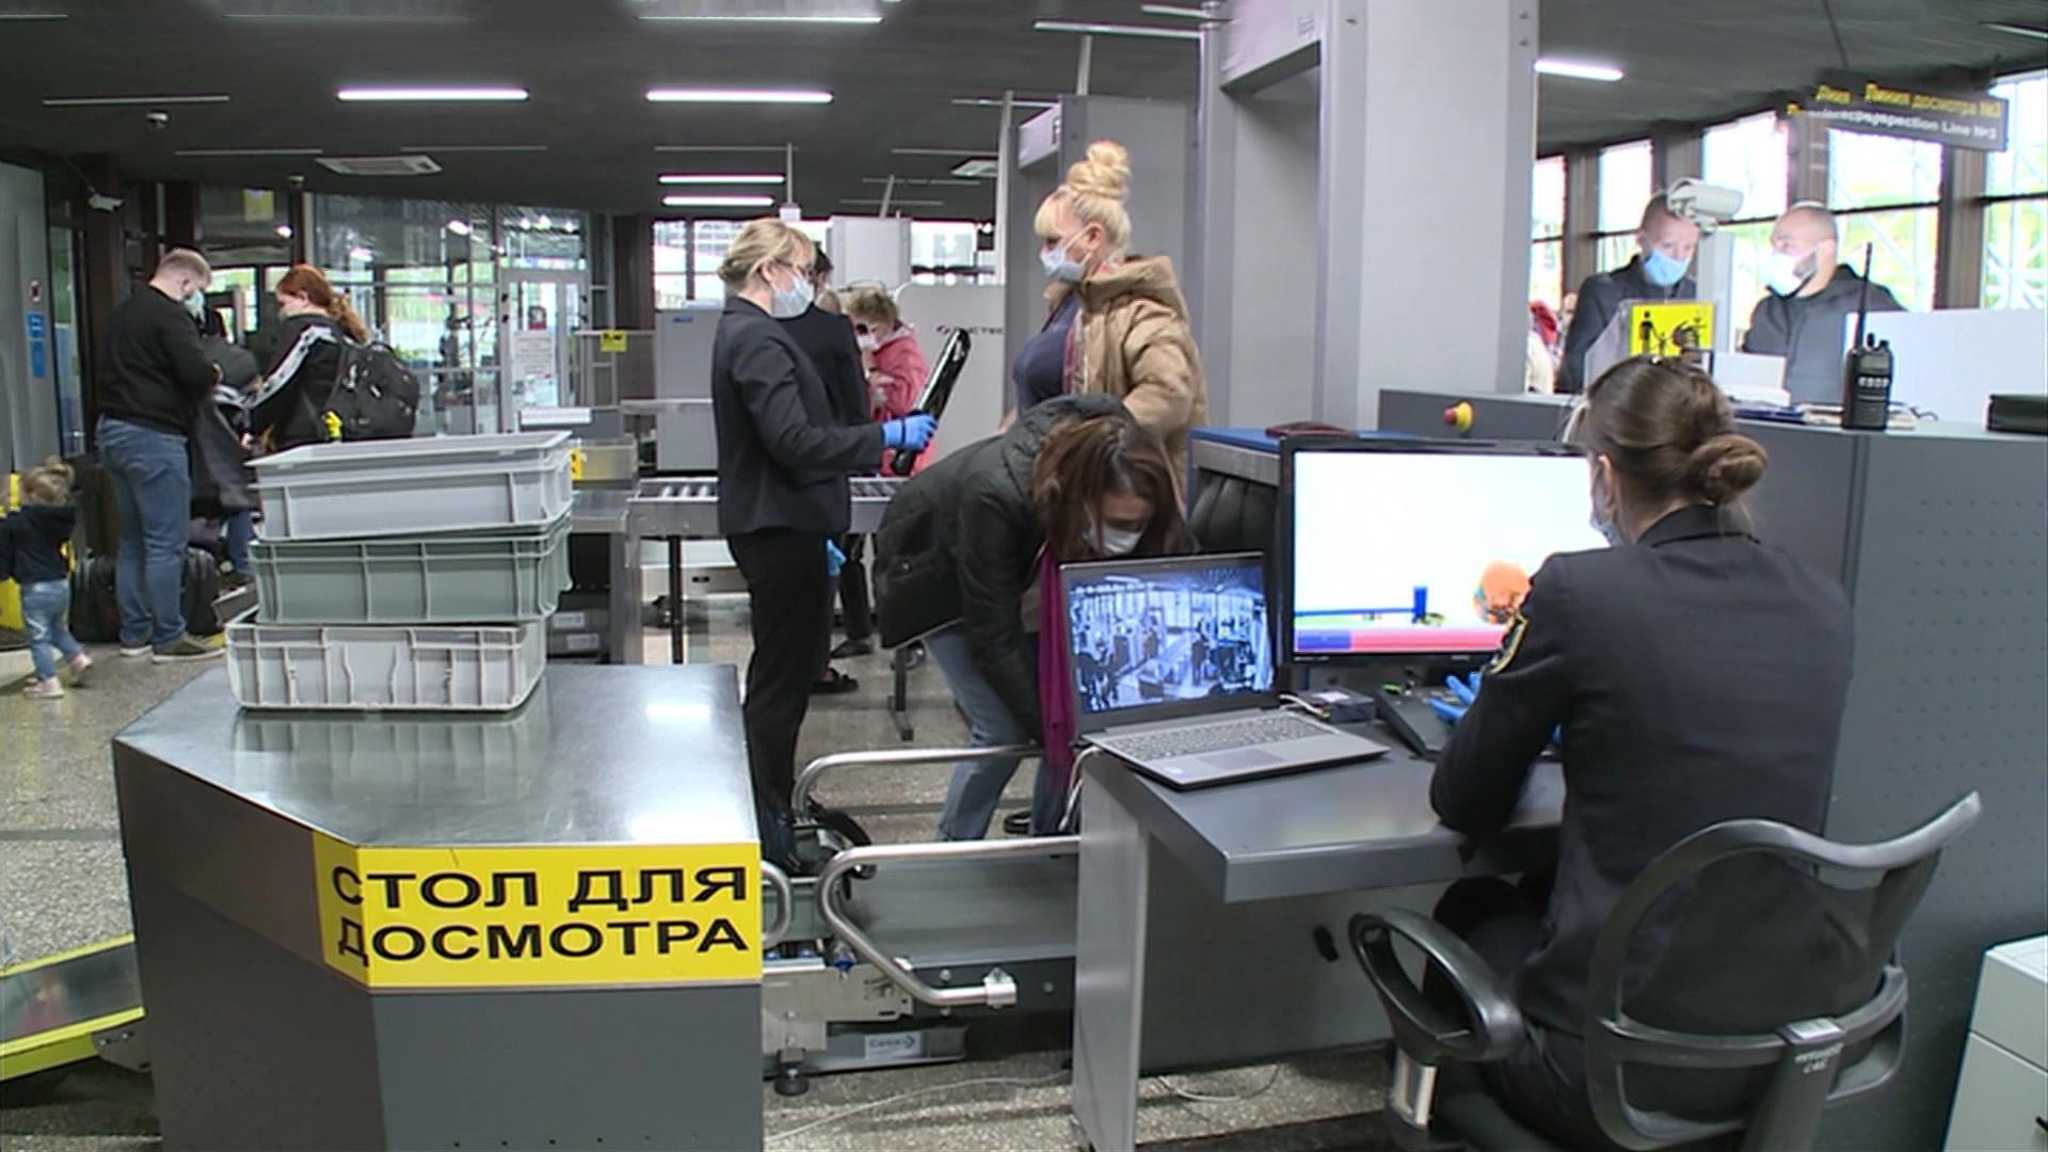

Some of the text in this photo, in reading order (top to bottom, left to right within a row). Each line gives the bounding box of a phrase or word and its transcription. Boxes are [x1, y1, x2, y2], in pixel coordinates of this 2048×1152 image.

[1941, 121, 1971, 136] Line
[332, 866, 747, 912] СТОЛ ДЛЯ
[338, 917, 749, 967] ДОСМОТРА
